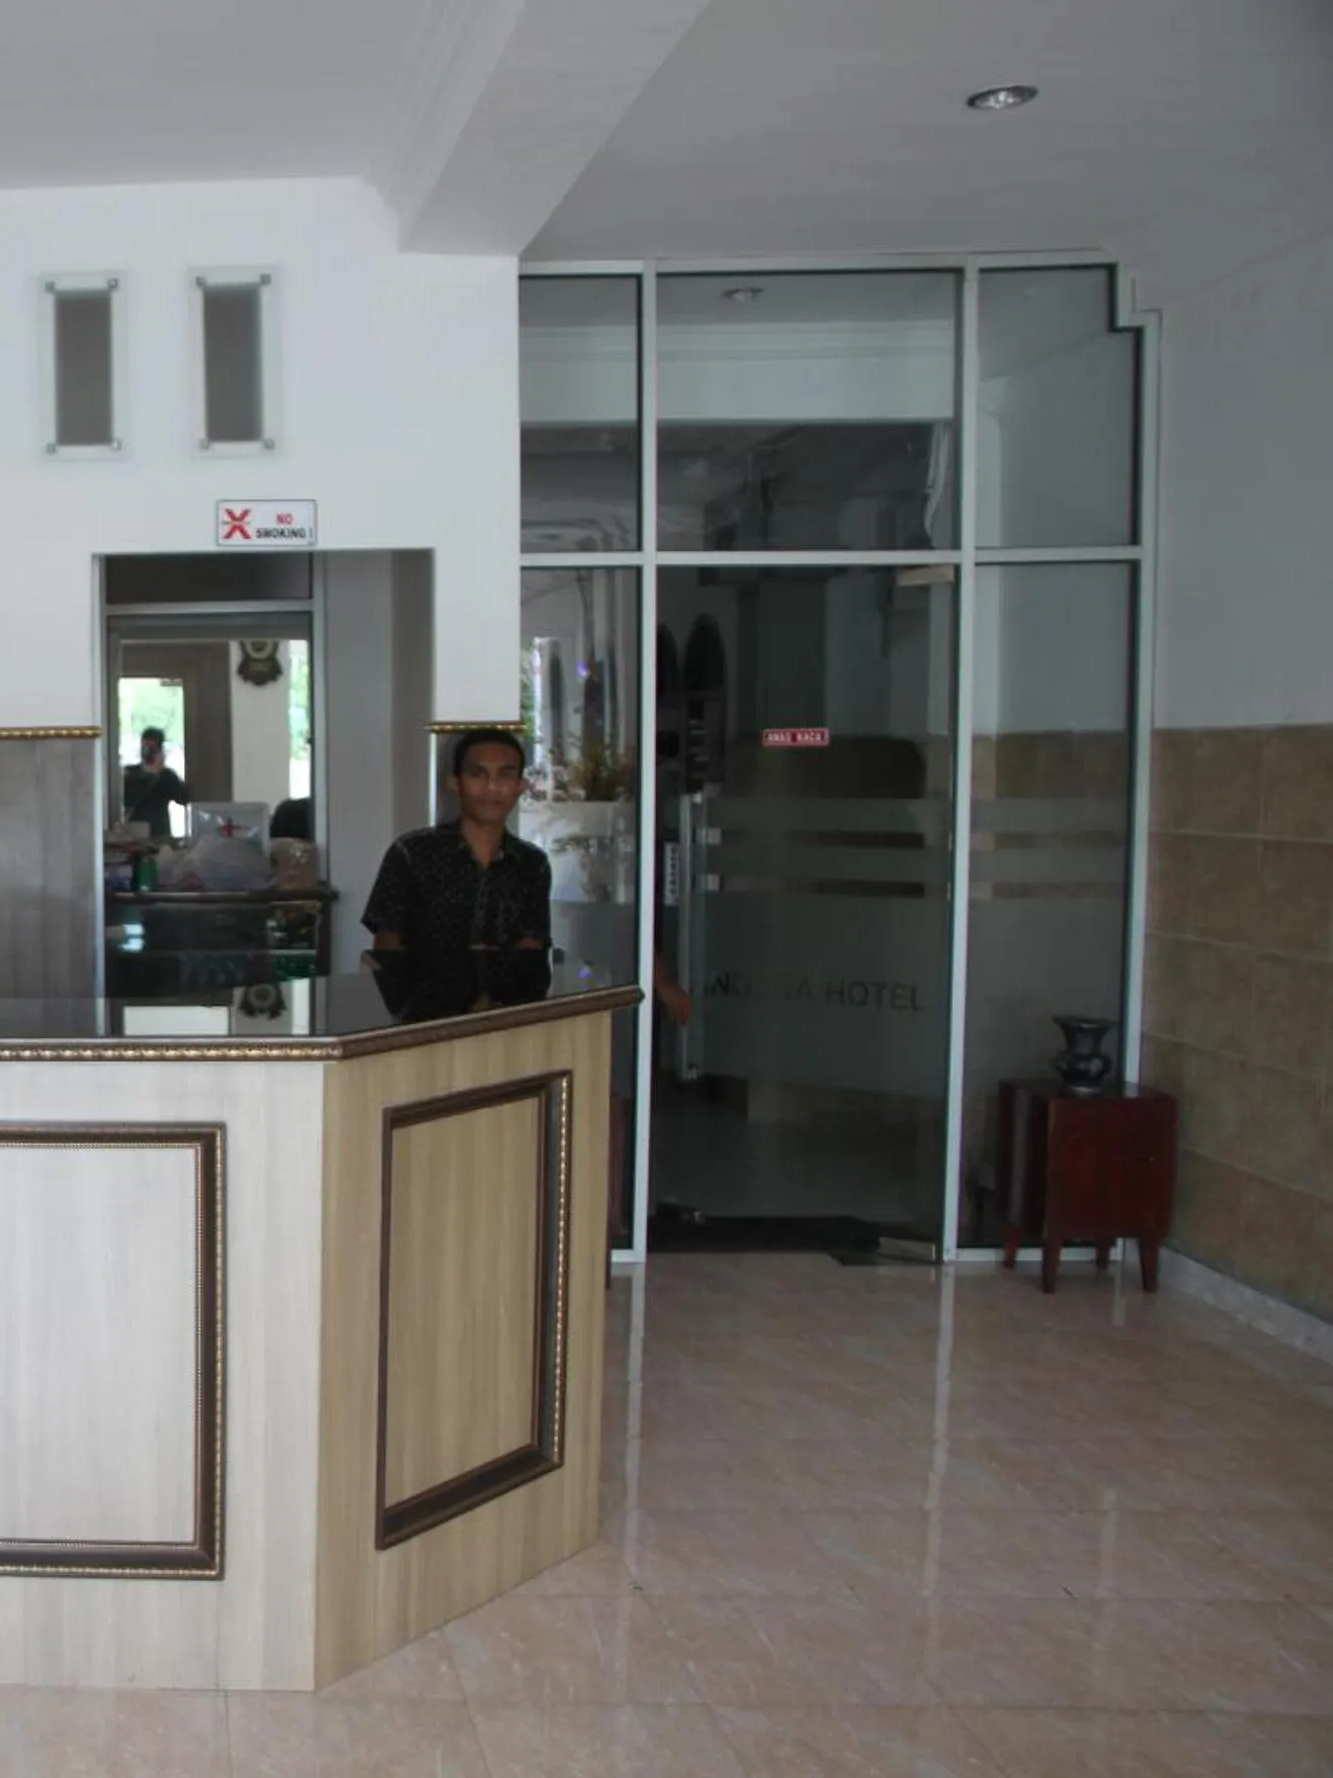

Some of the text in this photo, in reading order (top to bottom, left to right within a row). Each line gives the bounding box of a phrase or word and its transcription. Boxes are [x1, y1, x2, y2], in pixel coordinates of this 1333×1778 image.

[276, 513, 293, 525] NO
[255, 527, 306, 539] SMOKING
[825, 979, 927, 1011] HOTEL
